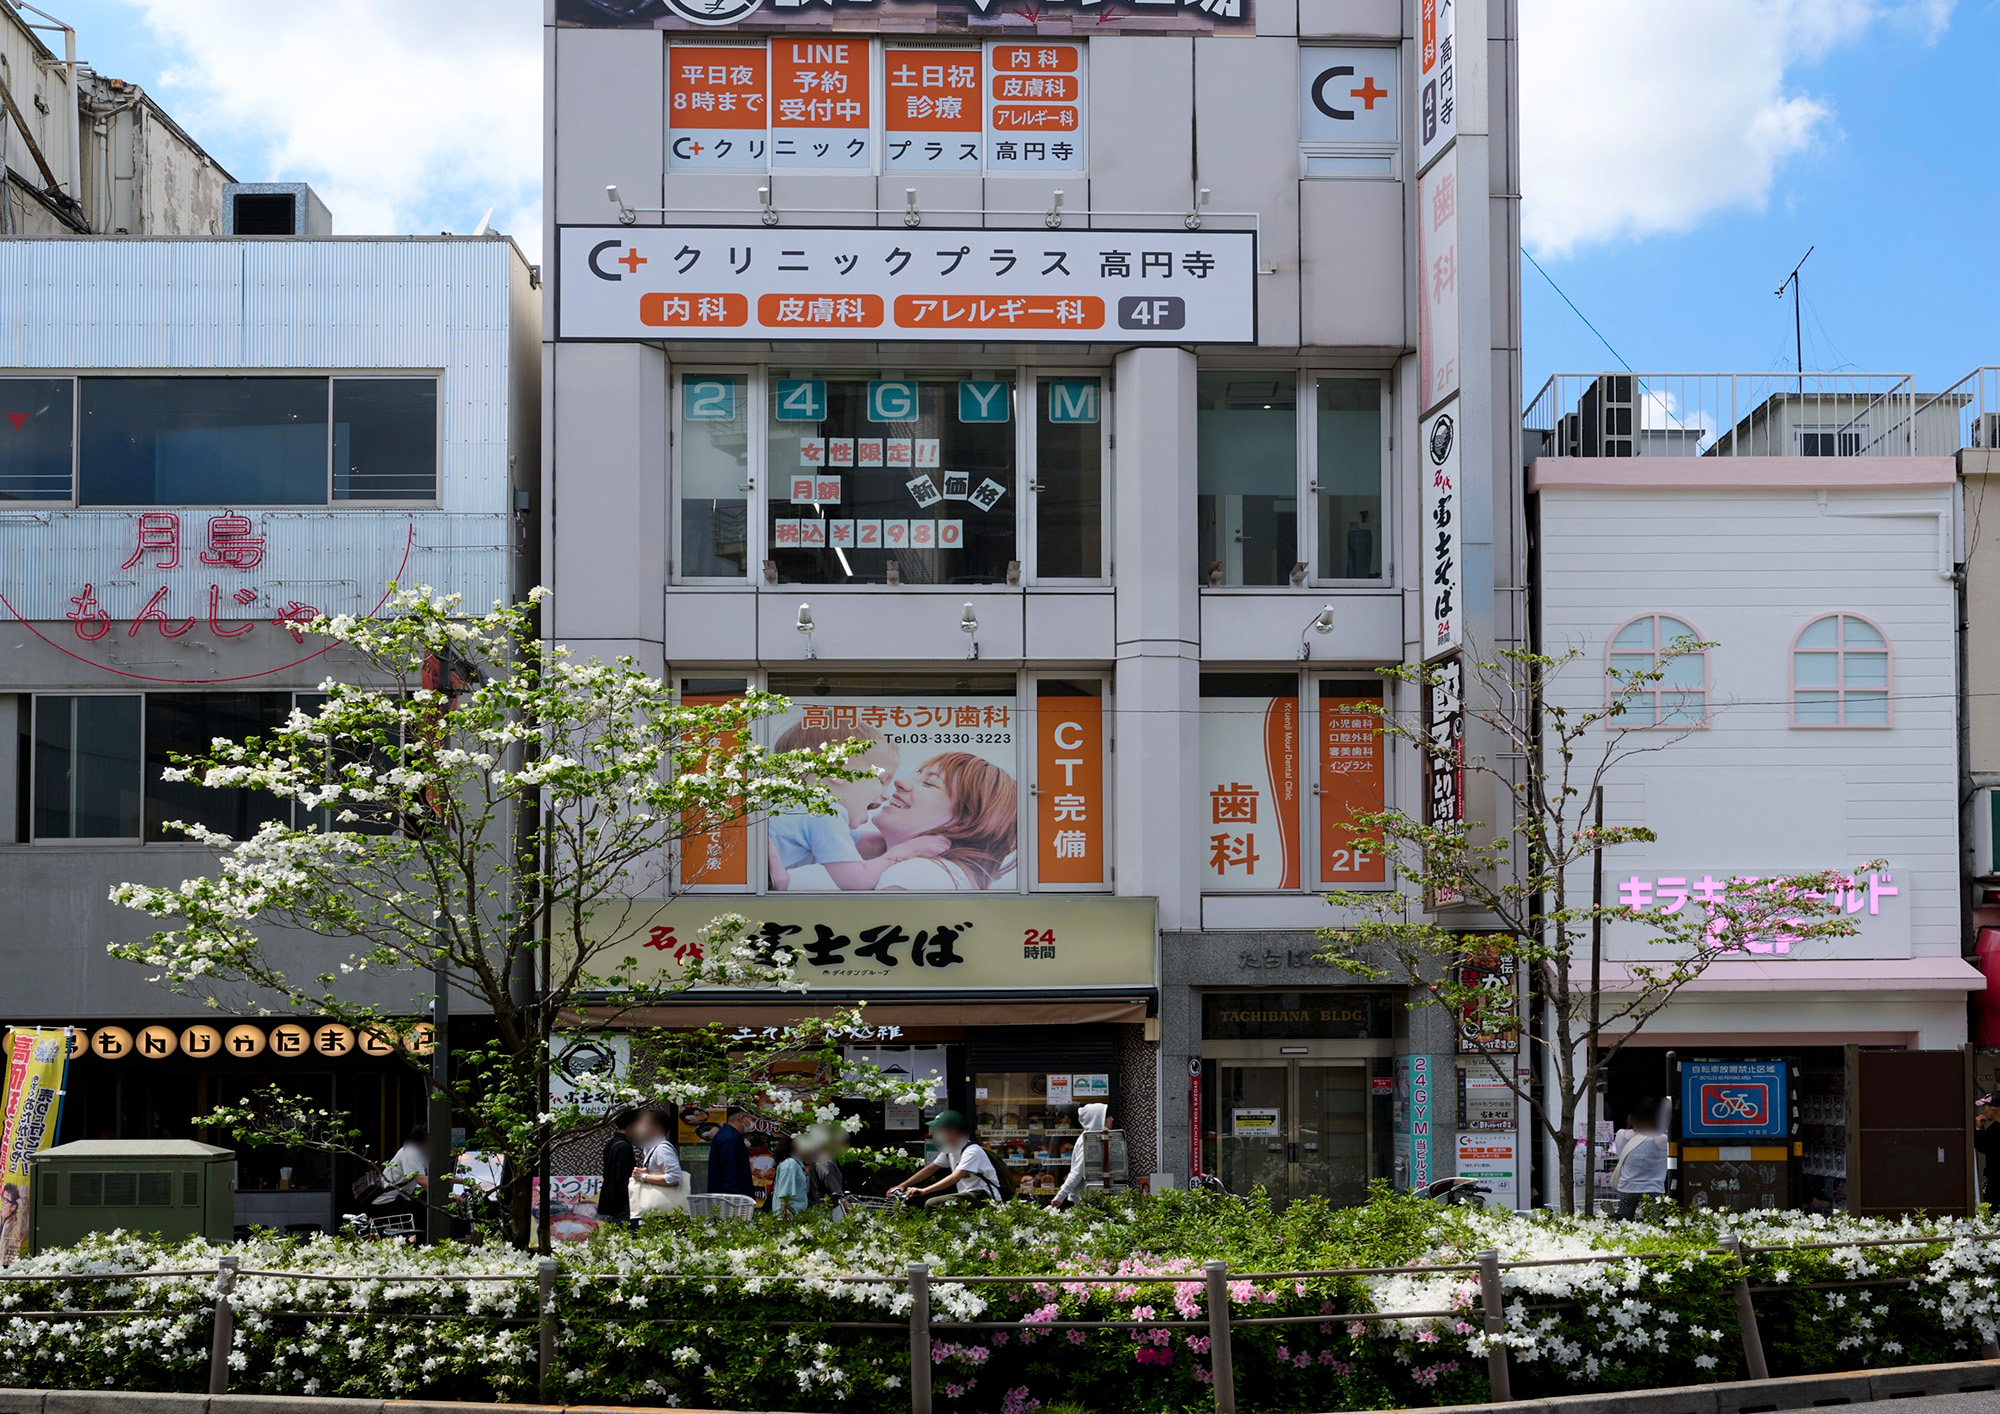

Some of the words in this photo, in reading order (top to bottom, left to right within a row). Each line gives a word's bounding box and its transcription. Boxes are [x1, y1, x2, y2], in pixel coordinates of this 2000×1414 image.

[792, 44, 849, 64] LINE
[1011, 49, 1060, 69] 内科
[681, 65, 754, 86] 平日夜
[793, 70, 848, 94] 予約
[890, 64, 976, 89] 土日祝
[1002, 78, 1067, 99] 皮膚科
[673, 91, 764, 112] 8時まで
[779, 98, 862, 122] 受付中
[906, 95, 963, 120] 診療
[997, 110, 1075, 127] アレルギー科
[1424, 87, 1434, 139] 4F
[1432, 172, 1457, 306] 歯科
[662, 296, 728, 323] 内科
[775, 297, 866, 324] 皮膚科
[911, 298, 1086, 325] アレルギー科
[1130, 300, 1170, 325] 4F
[1436, 358, 1455, 392] 2F
[793, 479, 841, 502] 月額
[910, 475, 1001, 507] 新価格
[121, 509, 266, 571] 月島
[66, 583, 321, 644] もんじゃ
[1437, 620, 1451, 636] 24
[1437, 633, 1451, 647] 時間
[801, 704, 1011, 730] 高円寺もうり歯科
[1329, 719, 1374, 729] 小児歯科
[883, 733, 1012, 746] Tel.03-3330-3223
[1329, 733, 1374, 743] 口腔外科
[1284, 754, 1293, 779] Dental
[1329, 761, 1374, 771] インプラント
[1053, 720, 1087, 859] CT完備
[1284, 780, 1293, 801] Clinic
[1209, 782, 1260, 876] 歯科
[1332, 849, 1374, 872] 2F
[1024, 928, 1056, 945] 24
[1024, 946, 1056, 959] 時間
[1221, 1010, 1311, 1023] TACHIBANA
[1320, 1010, 1367, 1022] BLDG.
[1692, 1065, 1776, 1074] 自転車放置禁止区域
